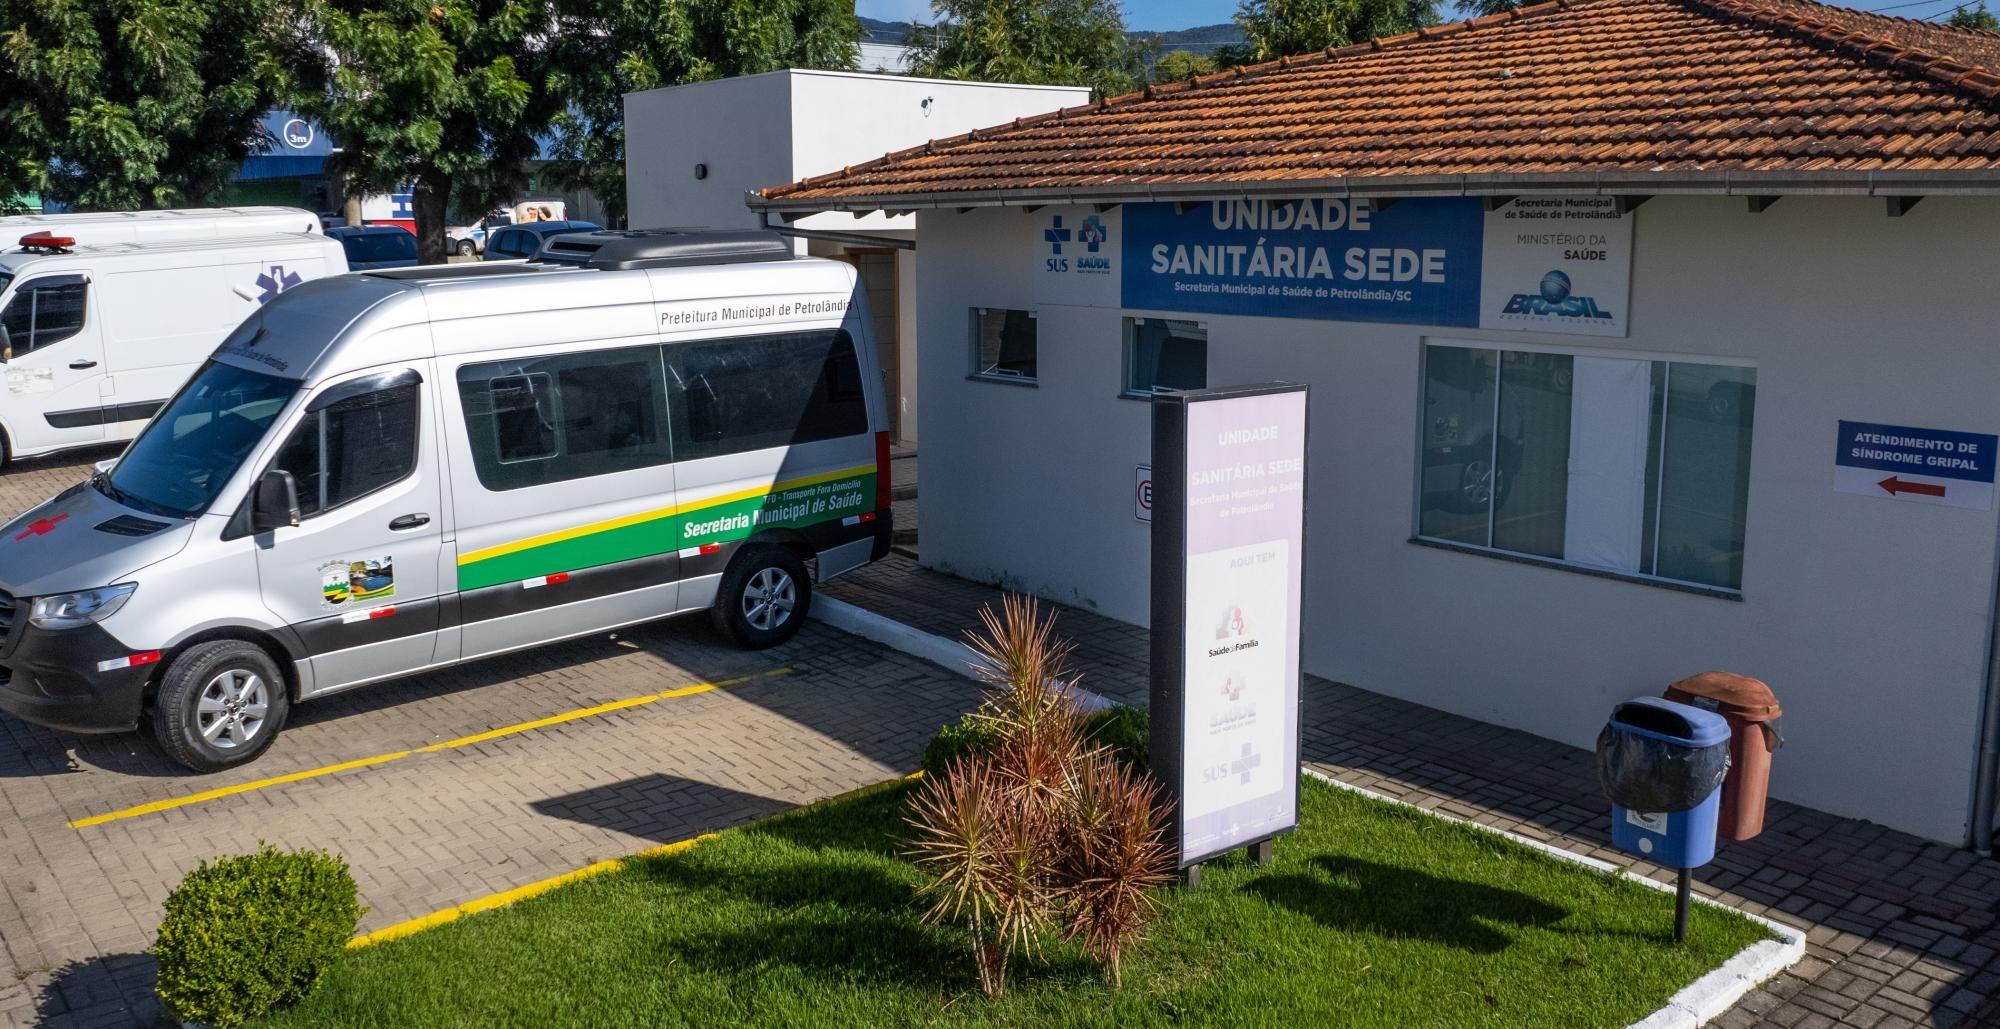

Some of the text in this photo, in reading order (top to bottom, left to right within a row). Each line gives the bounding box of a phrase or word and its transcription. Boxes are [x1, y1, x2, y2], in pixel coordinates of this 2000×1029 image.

[1514, 198, 1612, 208] Secretaria Municipal
[1212, 198, 1371, 231] UNIDADE
[1505, 210, 1516, 219] de
[1518, 210, 1547, 219] Saúde
[1550, 210, 1562, 219] de
[1517, 232, 1607, 246] MINISTÉRIO DA
[1151, 237, 1446, 283] SANITÁRIA SEDE
[1564, 248, 1607, 260] SAÚDE
[1046, 258, 1068, 273] SUS
[1174, 281, 1219, 293] Secretaria
[1221, 283, 1265, 296] Municipal
[1268, 285, 1280, 296] de
[1282, 286, 1312, 297] Saúde
[1315, 287, 1328, 298] de
[661, 299, 852, 325] Prefeitura Municipal de Petrolândia
[1218, 425, 1279, 446] UNIDADE
[1855, 432, 1978, 454] ATENDIMENTO DE
[1852, 446, 1979, 470] SÍNDROME GRIPAL
[1191, 457, 1301, 486] SANITÁRIA SEDE
[817, 485, 831, 494] Fora
[684, 491, 862, 538] Secretaria Municipal de Saúde
[1229, 552, 1276, 568] AQUI TEM
[1202, 762, 1228, 784] SUS
